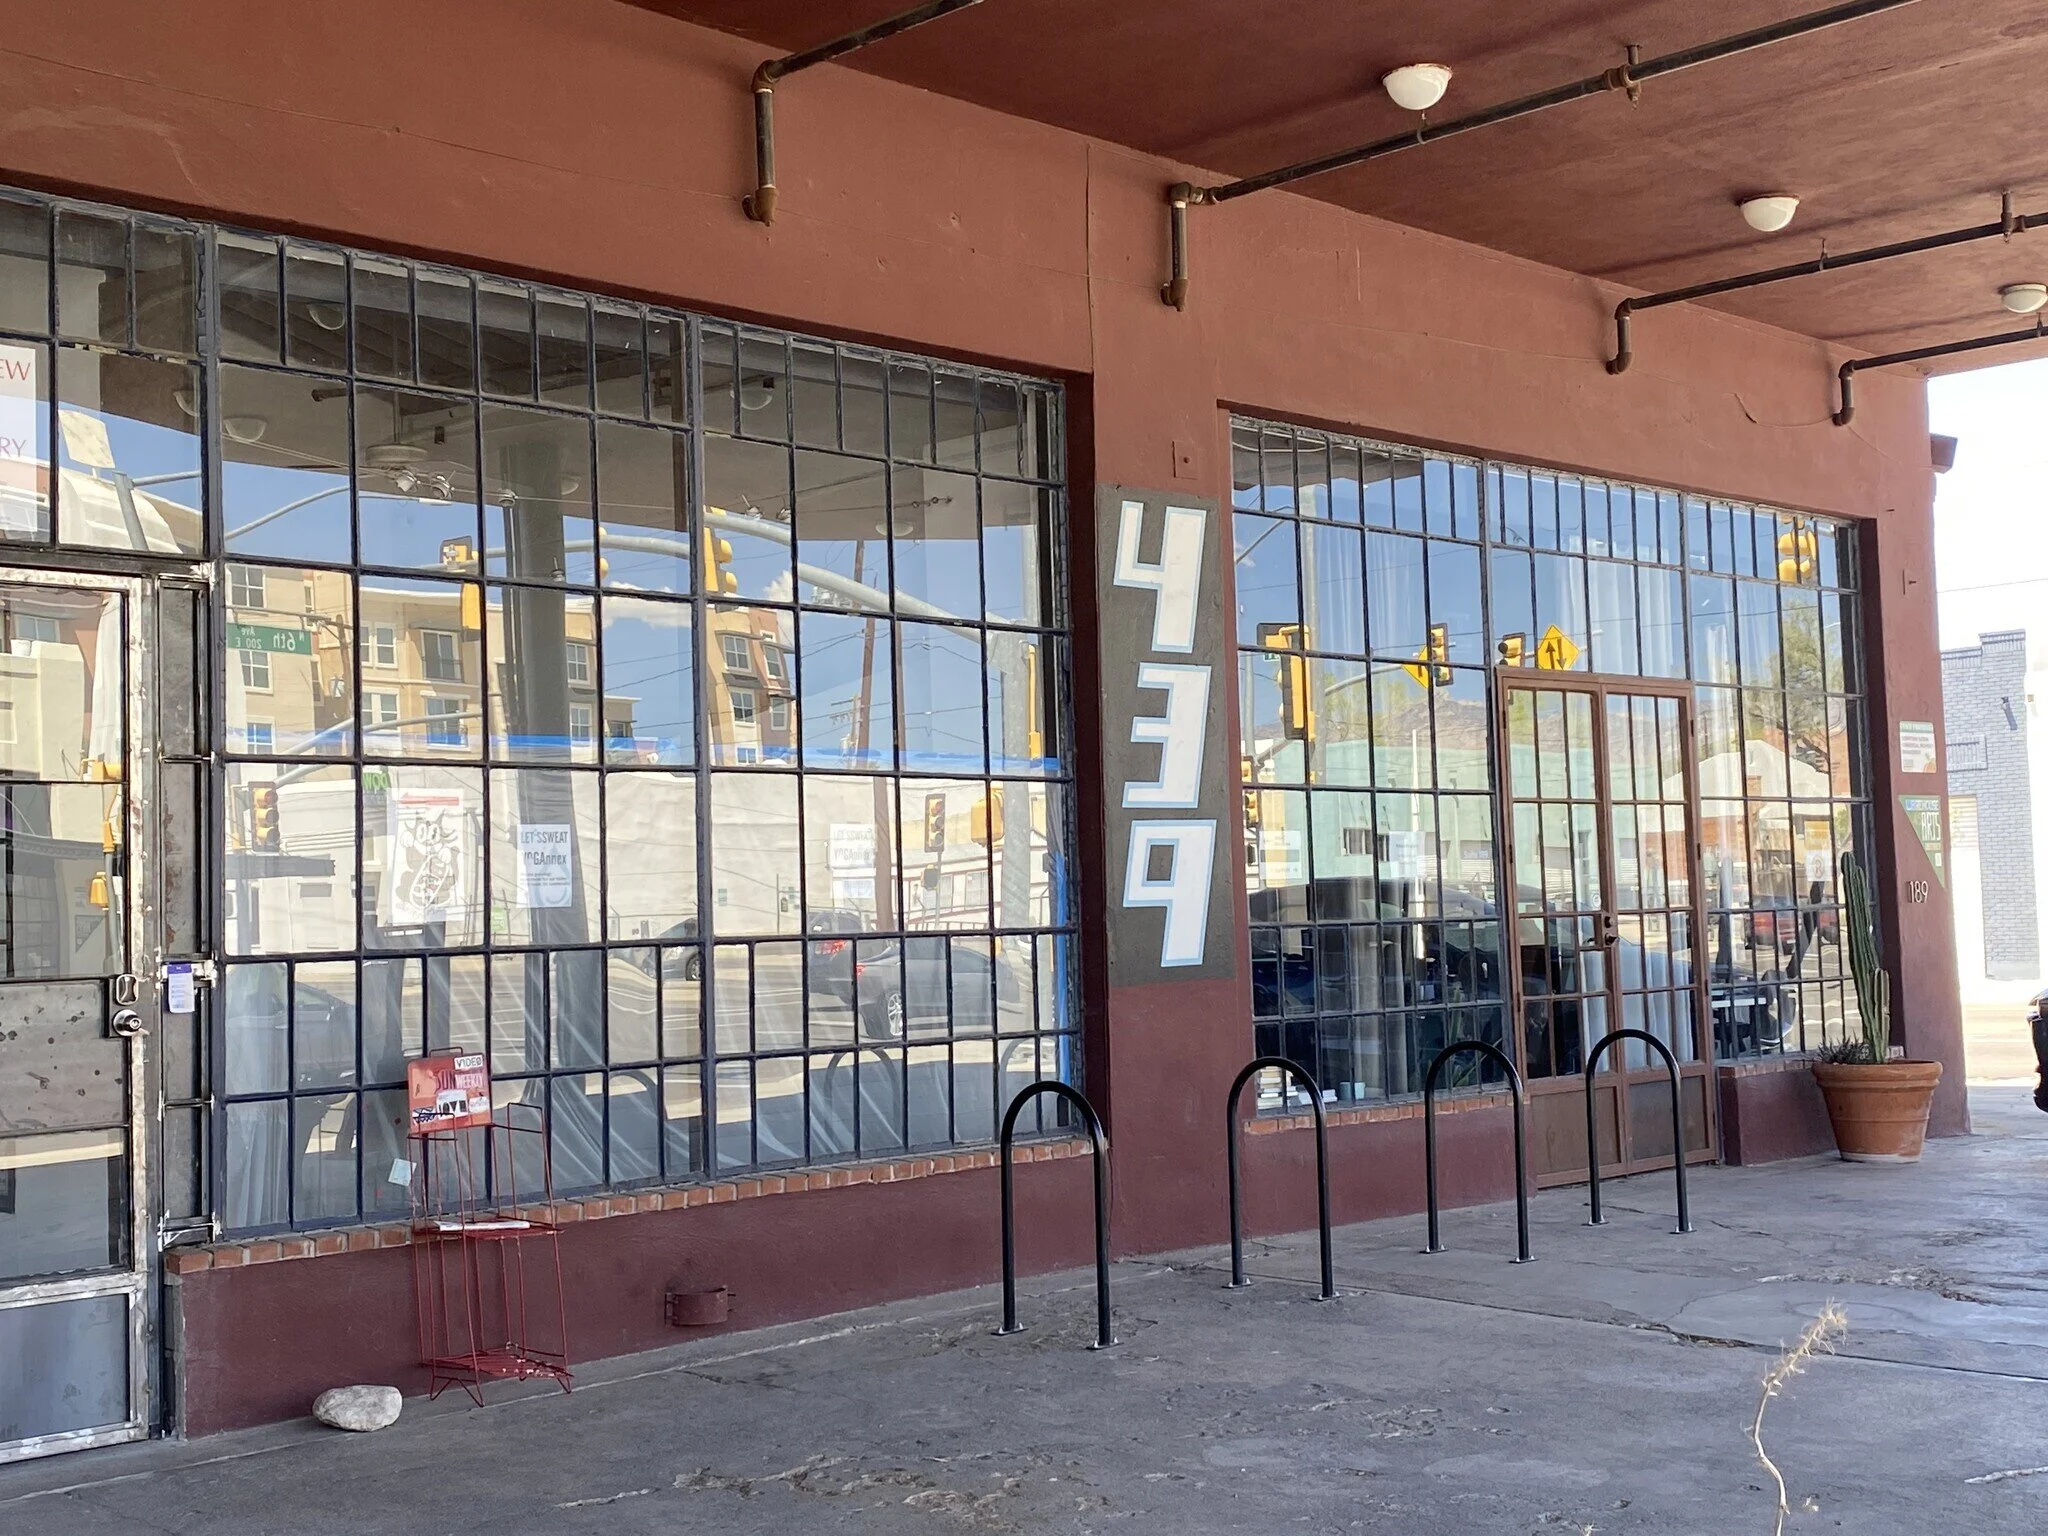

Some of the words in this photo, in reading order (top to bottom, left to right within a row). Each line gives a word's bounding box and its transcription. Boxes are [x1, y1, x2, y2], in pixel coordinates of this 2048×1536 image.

[1113, 500, 1217, 968] 439
[1921, 811, 1941, 841] ARTS
[1909, 880, 1928, 903] 189
